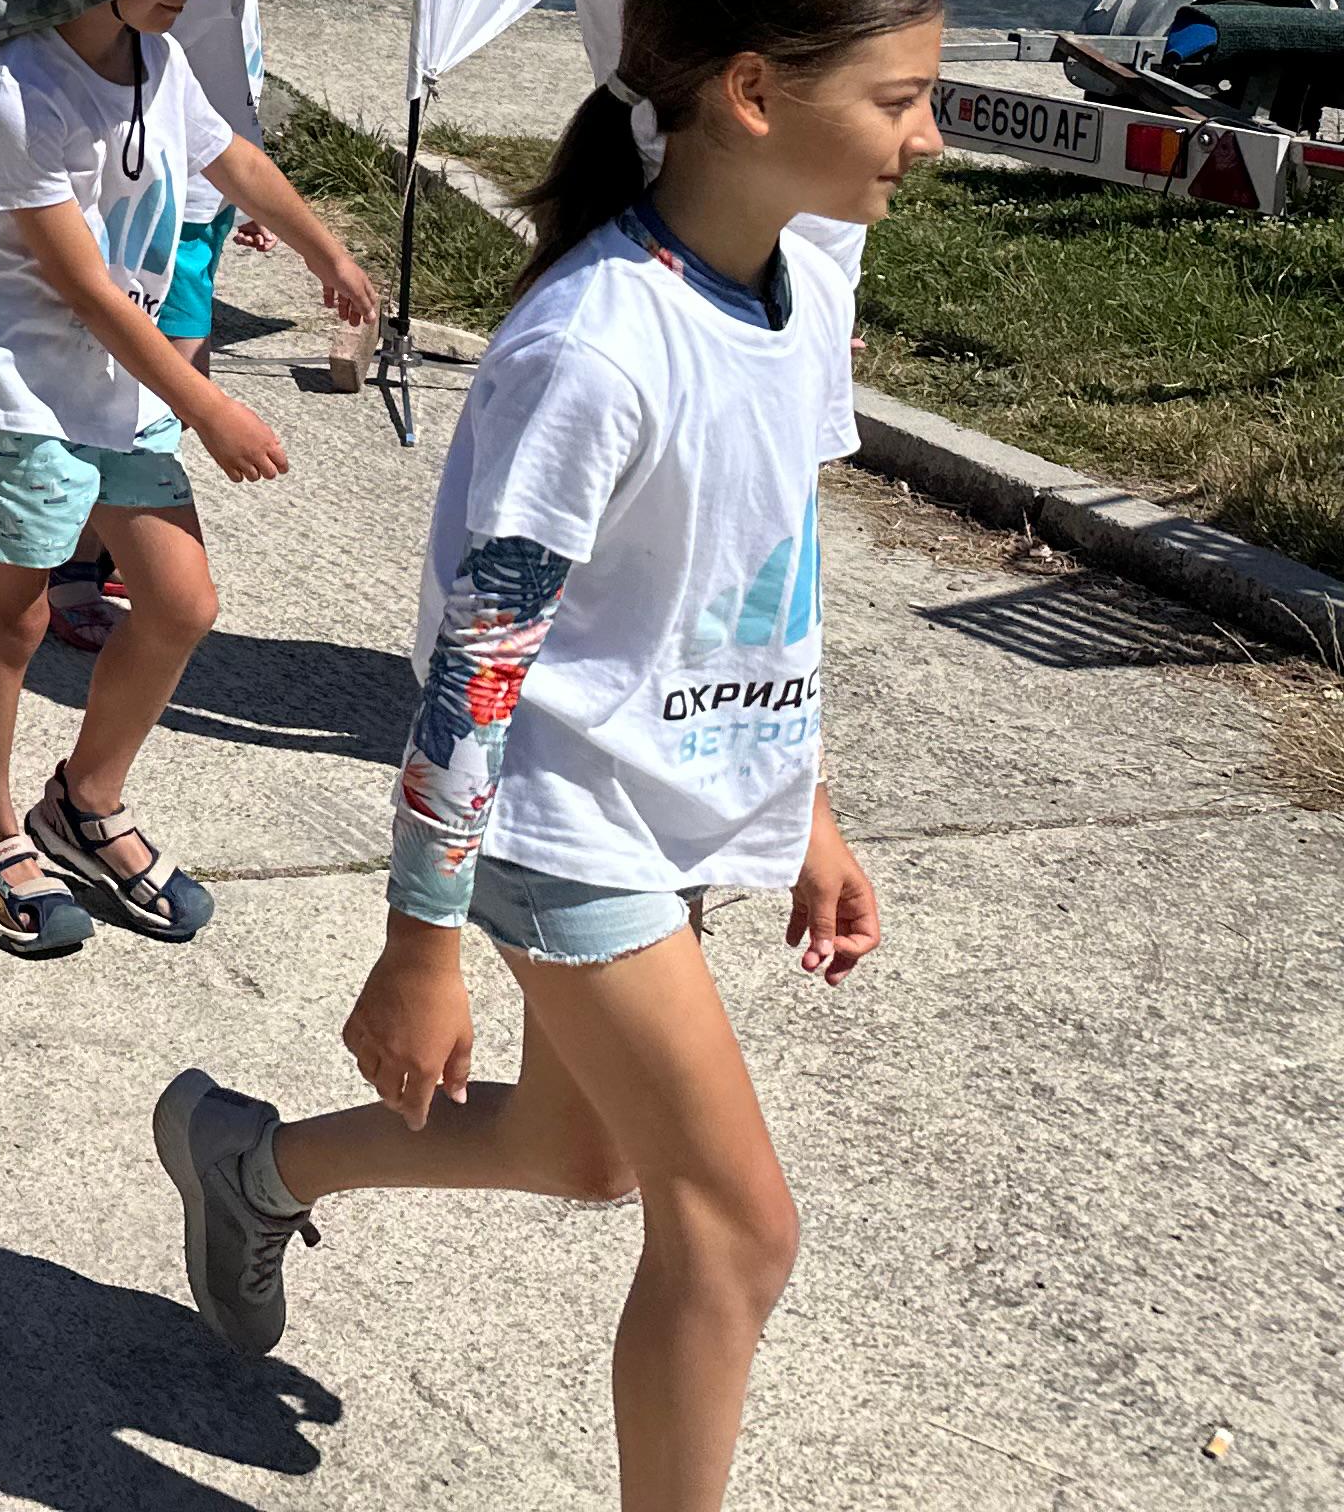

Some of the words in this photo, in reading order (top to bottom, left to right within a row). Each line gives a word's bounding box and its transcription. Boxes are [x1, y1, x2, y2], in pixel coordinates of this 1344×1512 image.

[973, 94, 1048, 144] 6690
[1053, 109, 1093, 152] AF
[663, 666, 819, 721] ОХРИДС
[679, 707, 819, 763] ВЕТРОВ
